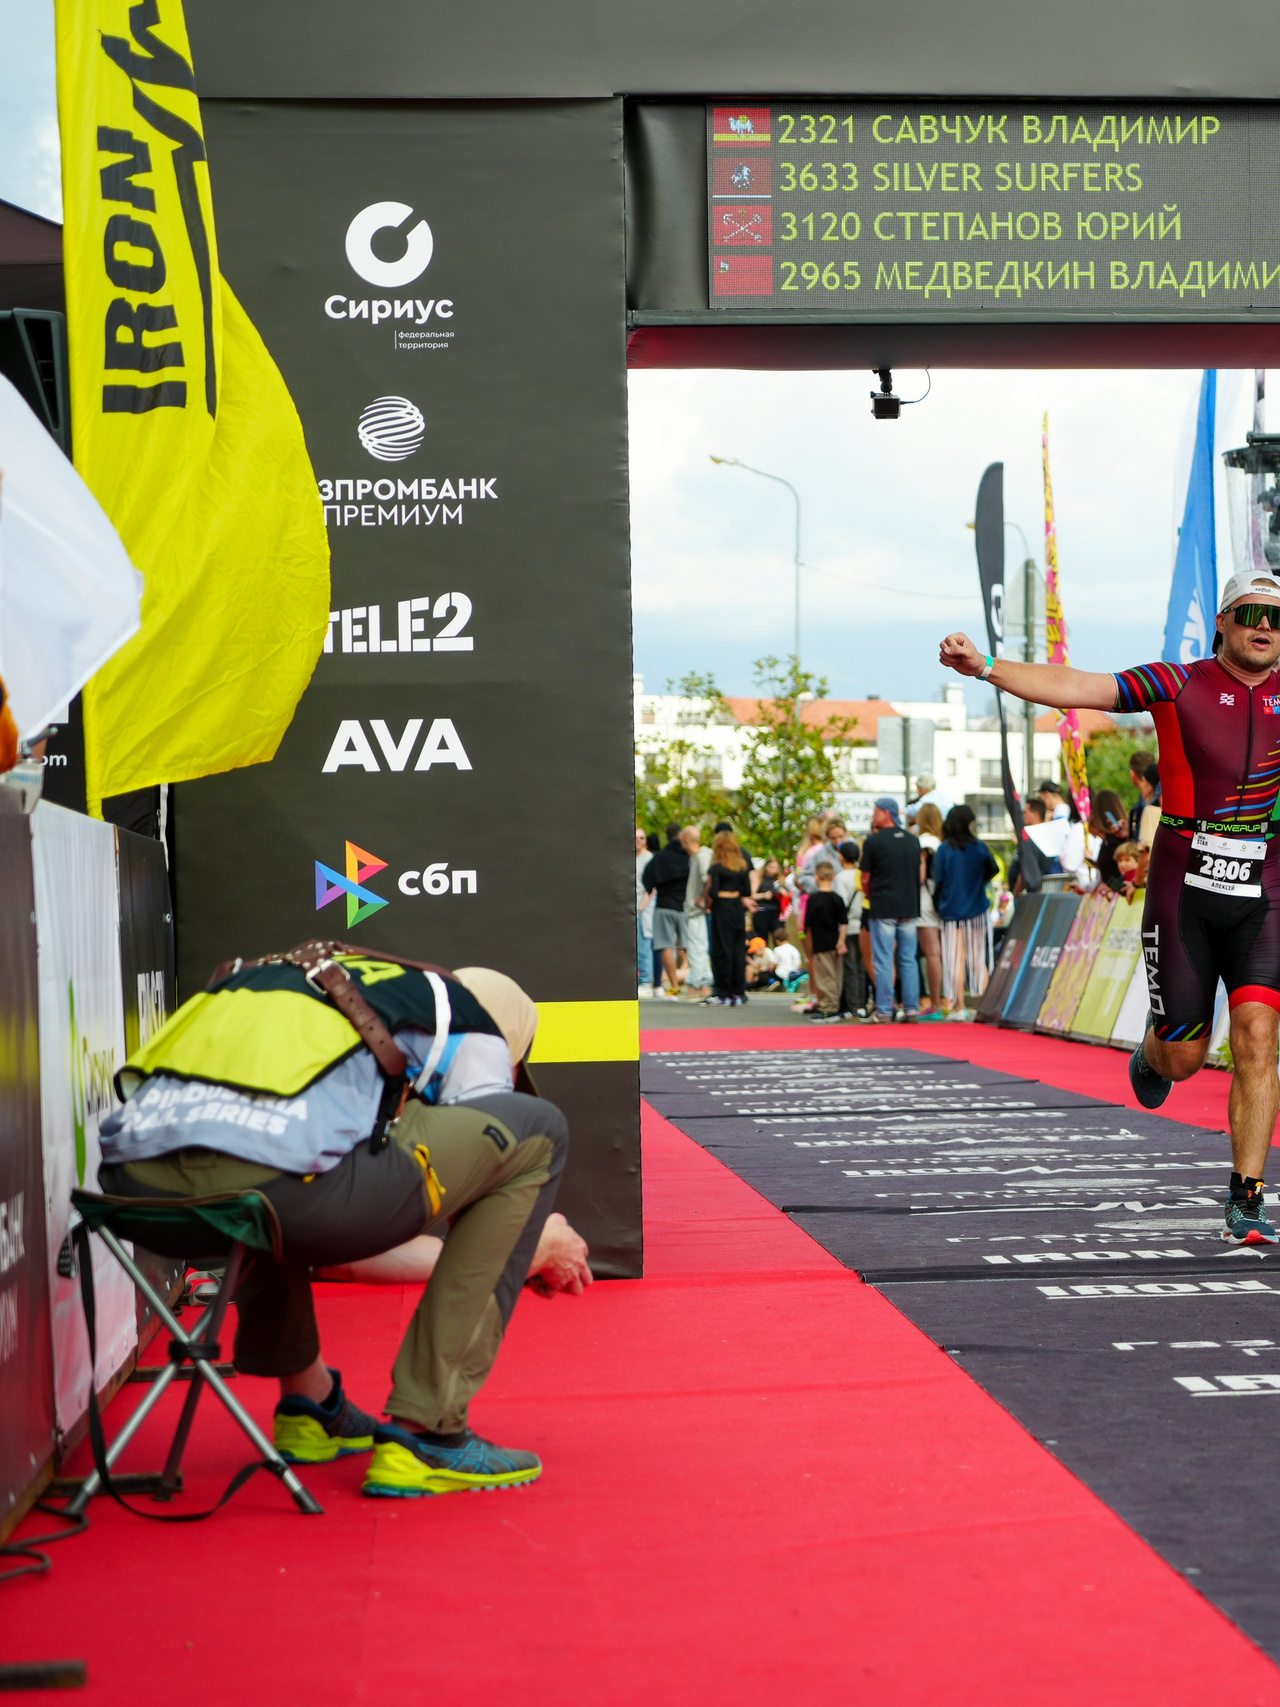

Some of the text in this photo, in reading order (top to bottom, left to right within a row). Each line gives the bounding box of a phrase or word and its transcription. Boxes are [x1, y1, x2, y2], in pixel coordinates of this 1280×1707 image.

[777, 115, 1221, 152] 2321 САВЧУК ВЛАДИМИР
[779, 162, 1143, 192] 3633 SILVER SURFERS
[780, 204, 1183, 241] 3120 СТЕПАНОВ ЮРИЙ
[97, 125, 187, 414] IRON
[780, 261, 862, 291] 2965
[875, 261, 1095, 298] МЕДВЕДКИН
[324, 294, 454, 325] Сириус
[398, 330, 455, 340] федеральная
[398, 341, 449, 350] территория
[318, 478, 498, 500] ЗПРОМБАНК
[323, 504, 463, 526] ПРЕМИУМ
[323, 592, 474, 653] TELE2
[322, 718, 473, 773] AVA
[1207, 822, 1261, 832] POWERUP
[398, 863, 477, 895] сбп
[1200, 855, 1251, 881] 2806
[1211, 882, 1236, 891] АЛЕКСЕЙ
[184, 1101, 289, 1135] SERIES
[982, 1249, 1194, 1264] IRON
[1036, 1280, 1271, 1297] IRON
